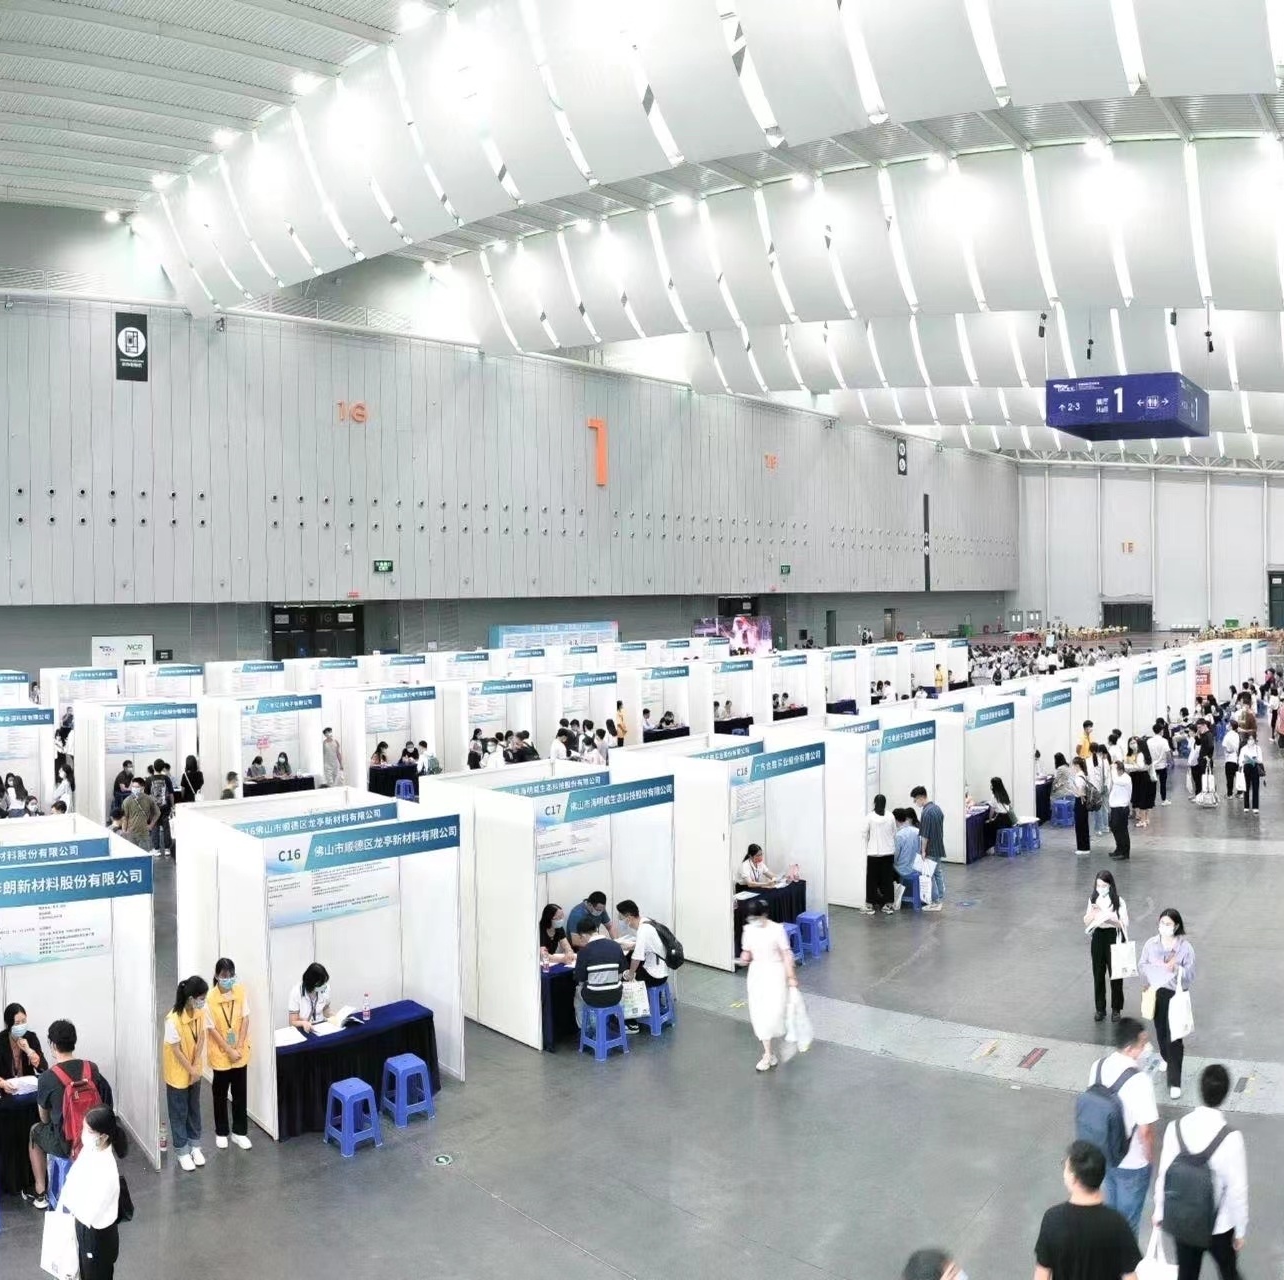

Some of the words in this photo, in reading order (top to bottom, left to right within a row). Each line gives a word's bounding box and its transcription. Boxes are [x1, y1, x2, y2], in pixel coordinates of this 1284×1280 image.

[1114, 387, 1123, 413] 1
[588, 418, 606, 487] 1
[545, 804, 561, 816] C17
[315, 824, 458, 857] 佛山市顺德区龙亭新材料有限公司
[278, 848, 301, 862] C16
